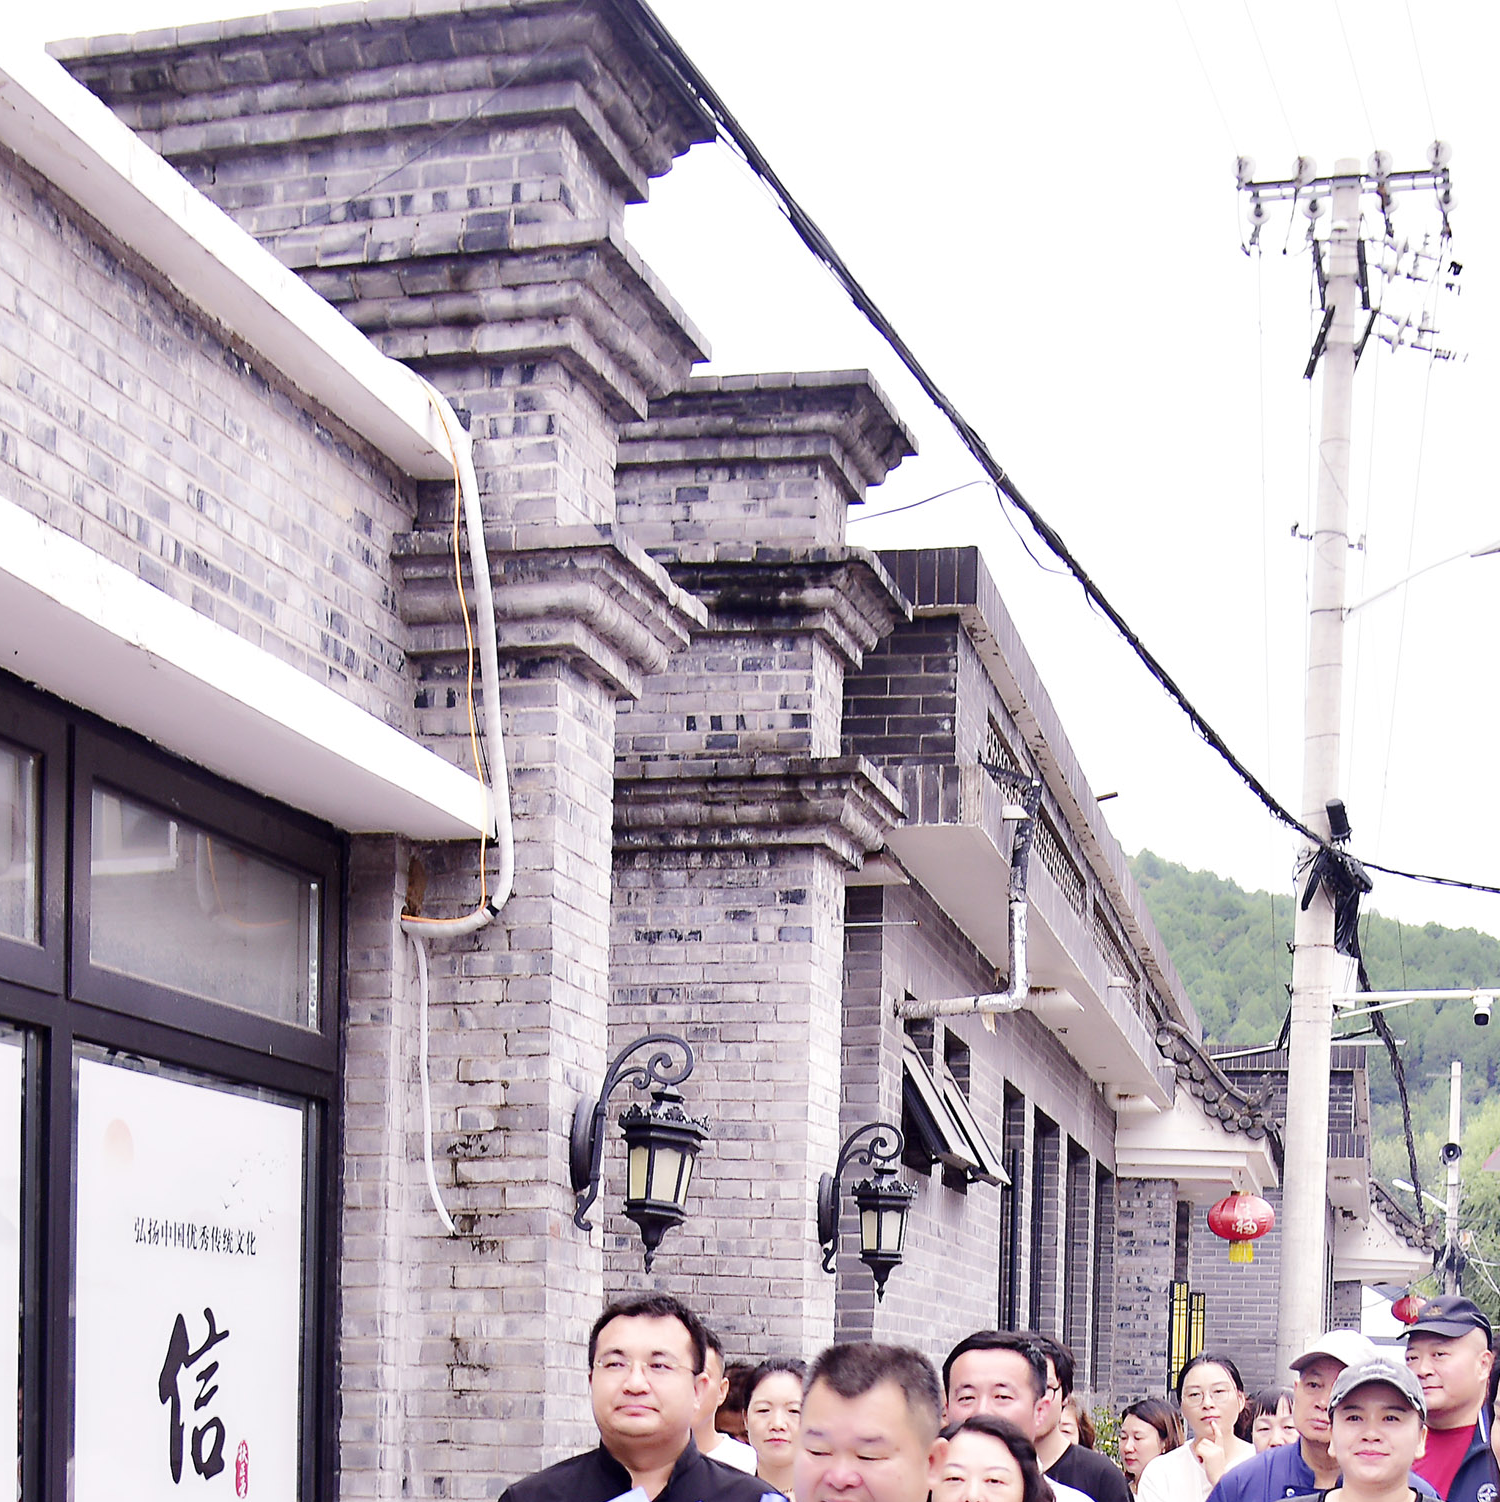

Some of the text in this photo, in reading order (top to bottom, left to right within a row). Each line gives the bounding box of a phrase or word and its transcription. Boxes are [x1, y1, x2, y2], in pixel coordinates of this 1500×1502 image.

[134, 1217, 257, 1256] 弘扬中国优秀传统文化
[159, 1307, 229, 1484] 信
